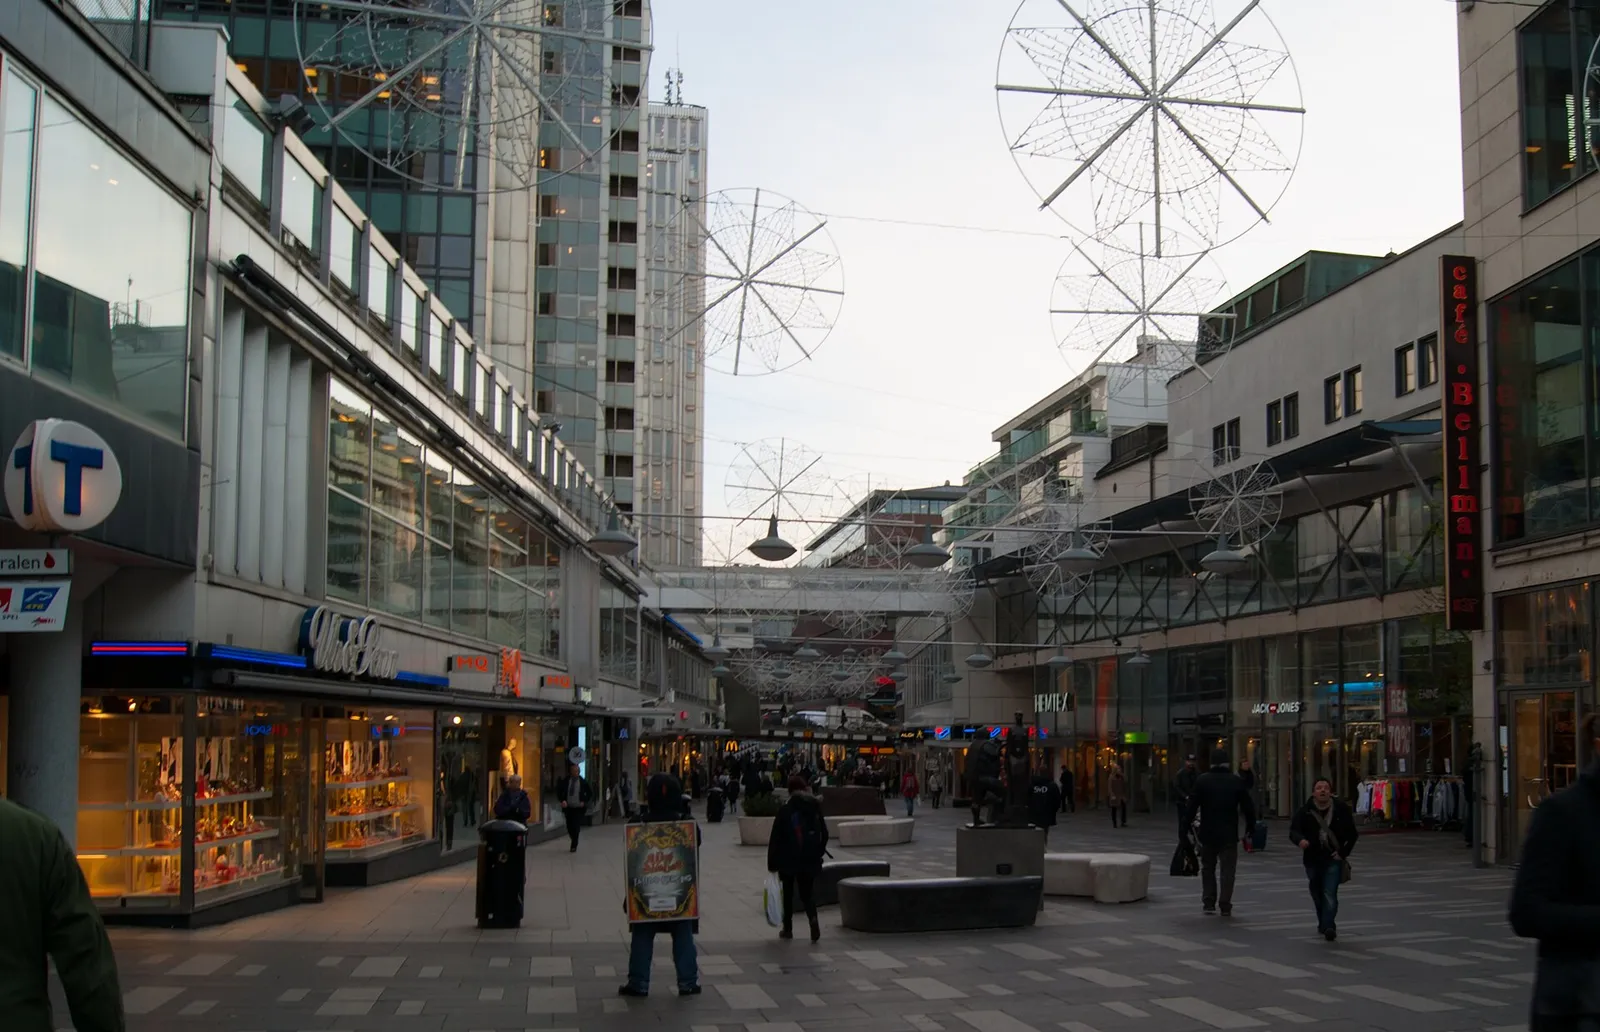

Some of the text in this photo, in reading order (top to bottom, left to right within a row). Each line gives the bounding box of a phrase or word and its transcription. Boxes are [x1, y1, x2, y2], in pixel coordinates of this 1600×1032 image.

[1451, 264, 1478, 560] café Bellman
[50, 439, 103, 516] T
[456, 655, 489, 672] MQ
[547, 676, 571, 688] MQ
[1251, 703, 1270, 714] JACK
[1276, 701, 1301, 714] JONES
[1387, 725, 1411, 754] 70%
[1033, 785, 1048, 794] SvD
